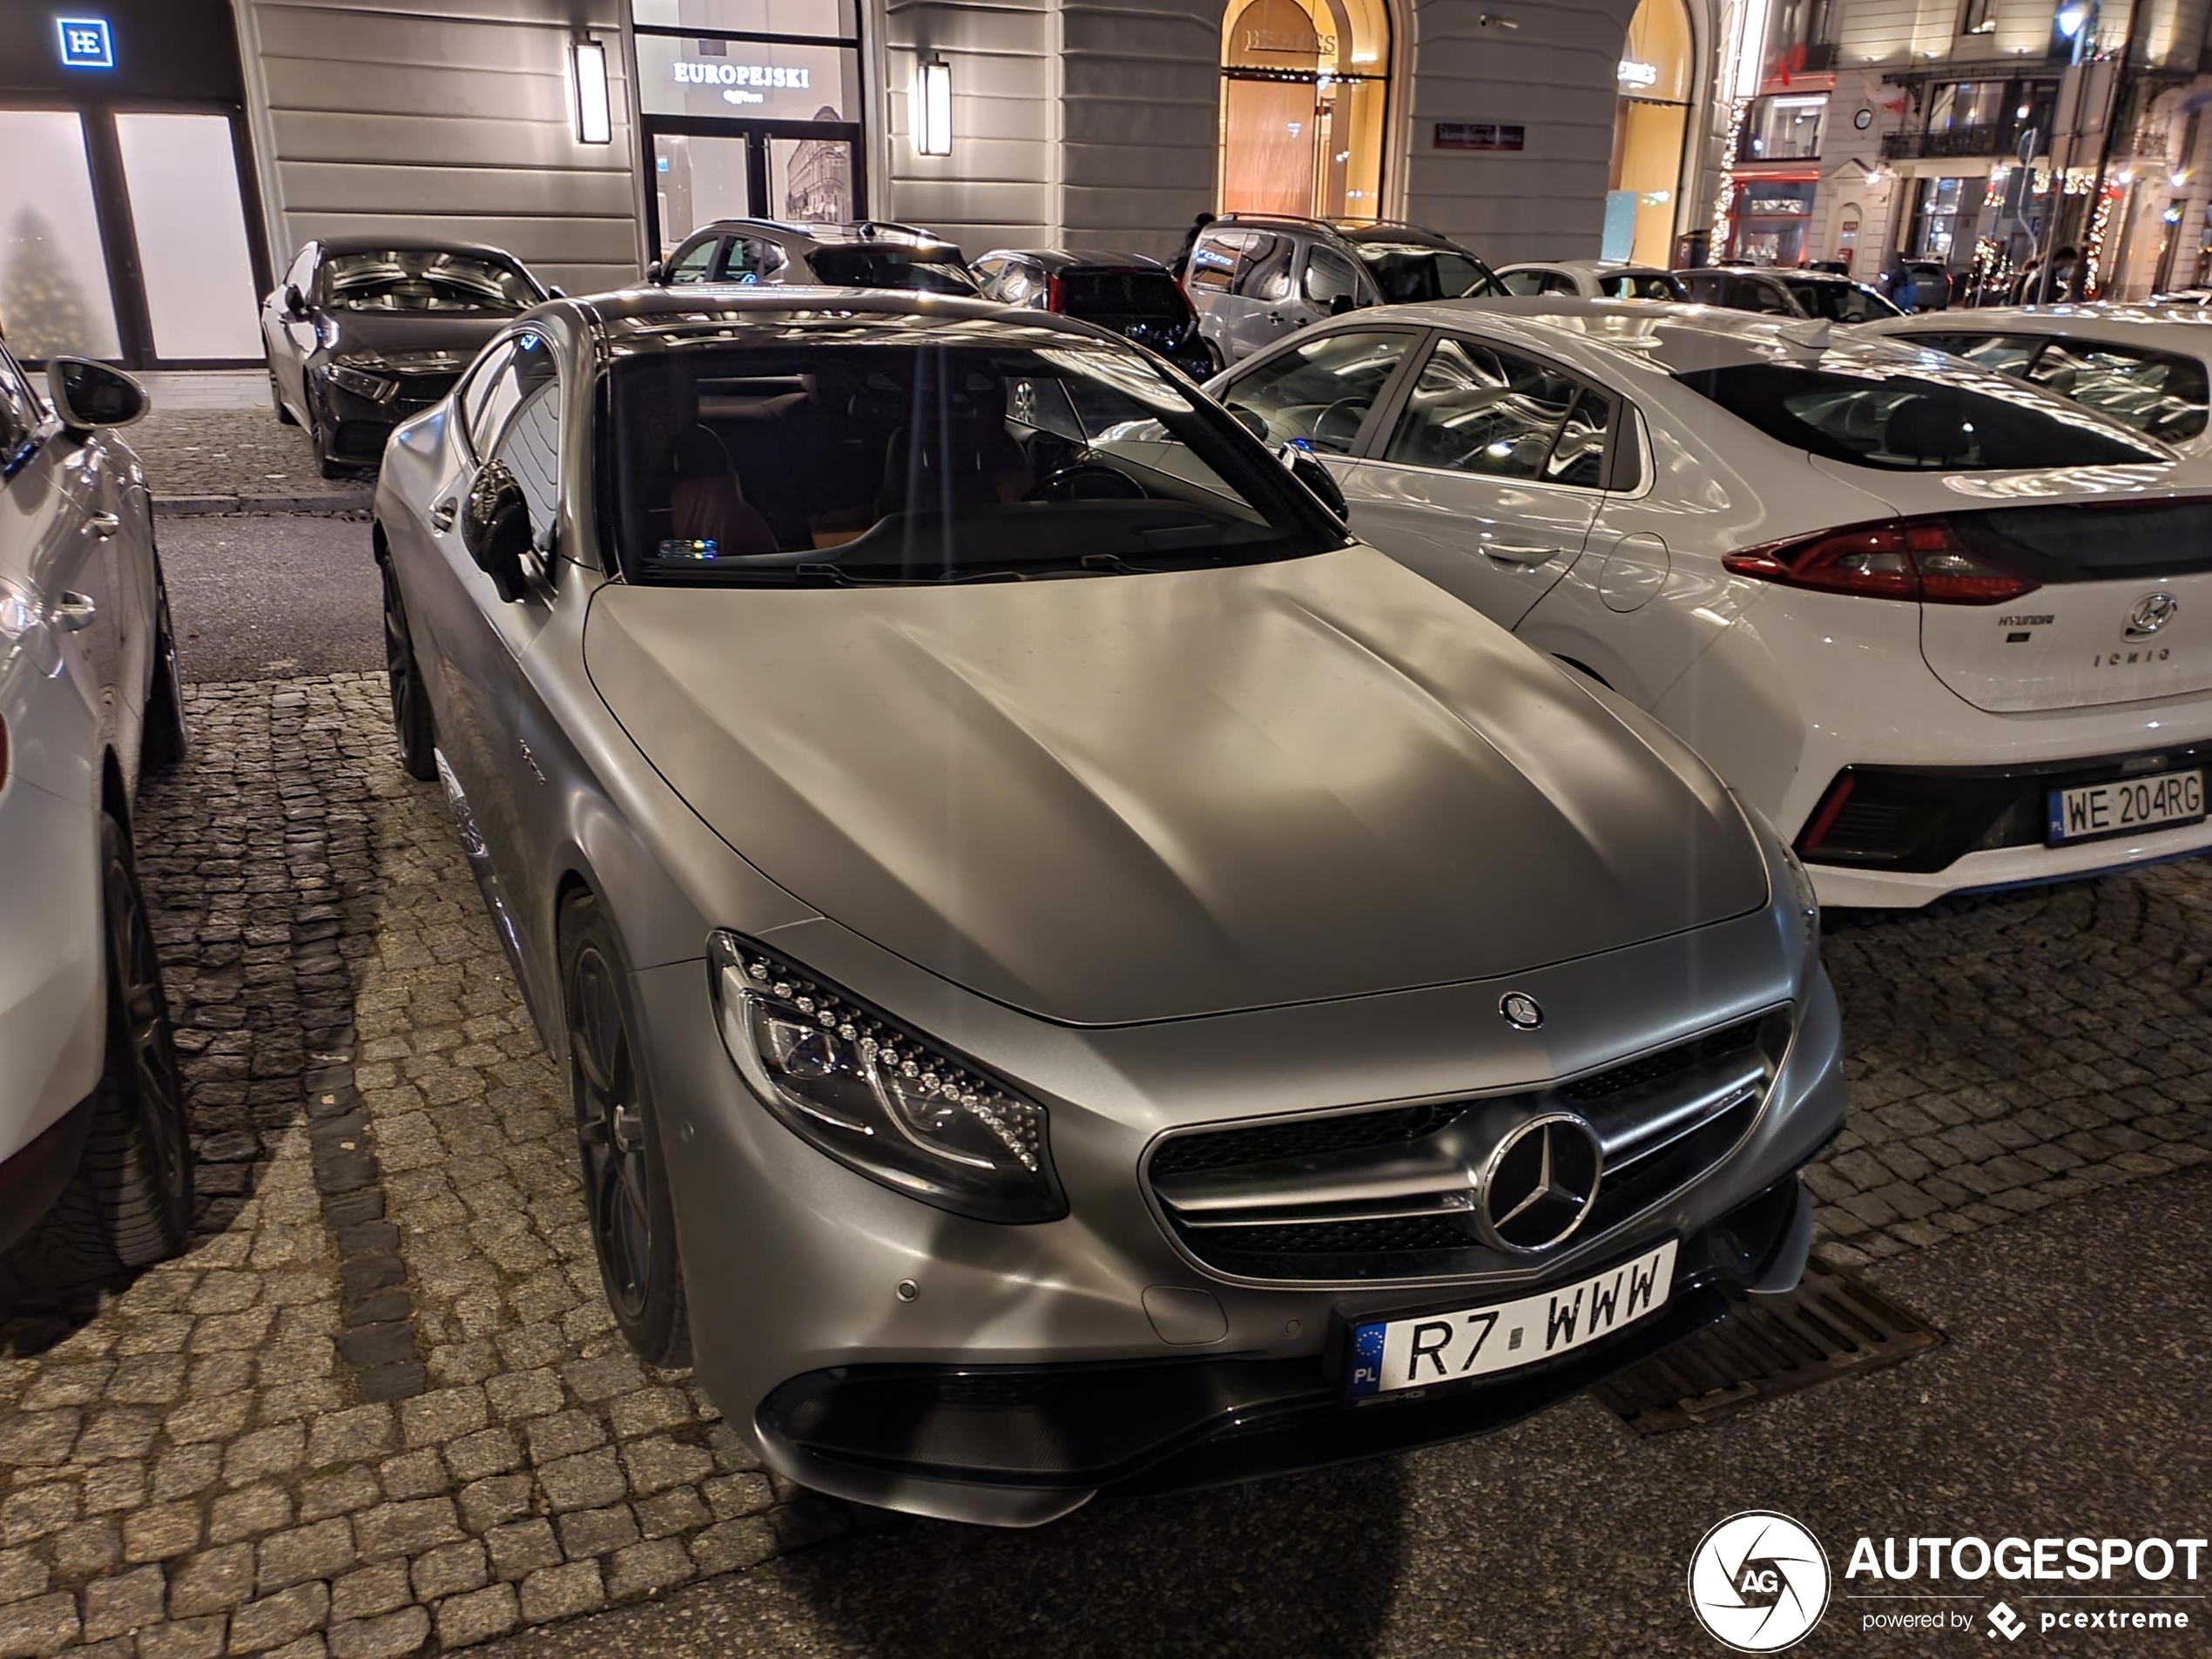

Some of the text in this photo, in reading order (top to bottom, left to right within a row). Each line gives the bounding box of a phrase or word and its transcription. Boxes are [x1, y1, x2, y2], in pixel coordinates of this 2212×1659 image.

[673, 62, 810, 89] EUROPEJSKI
[1998, 614, 2054, 626] HYUNDAI
[2094, 648, 2170, 668] IONIQ
[2067, 775, 2200, 832] WE 204RG
[2052, 821, 2062, 832] PL
[1407, 1253, 1662, 1381] R7 WWW
[1353, 1366, 1377, 1385] PL
